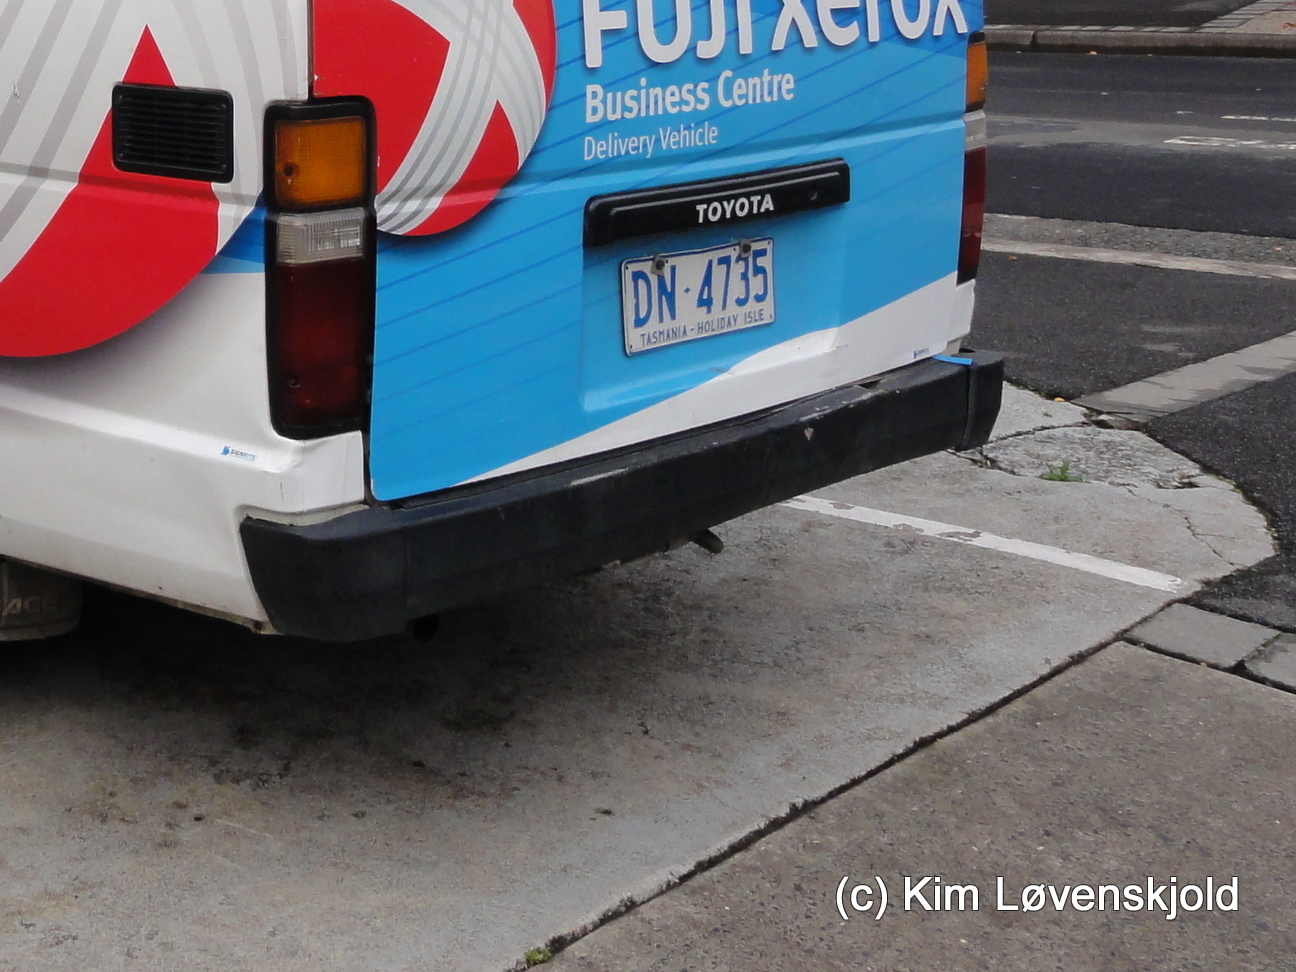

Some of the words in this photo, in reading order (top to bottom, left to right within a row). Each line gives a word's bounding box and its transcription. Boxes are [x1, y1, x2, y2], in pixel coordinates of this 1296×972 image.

[585, 78, 710, 123] Business
[717, 68, 795, 108] Centre
[584, 131, 655, 160] Delivery
[659, 122, 718, 150] Vehicle
[696, 194, 774, 223] TOYOTA
[744, 308, 765, 325] ISLE
